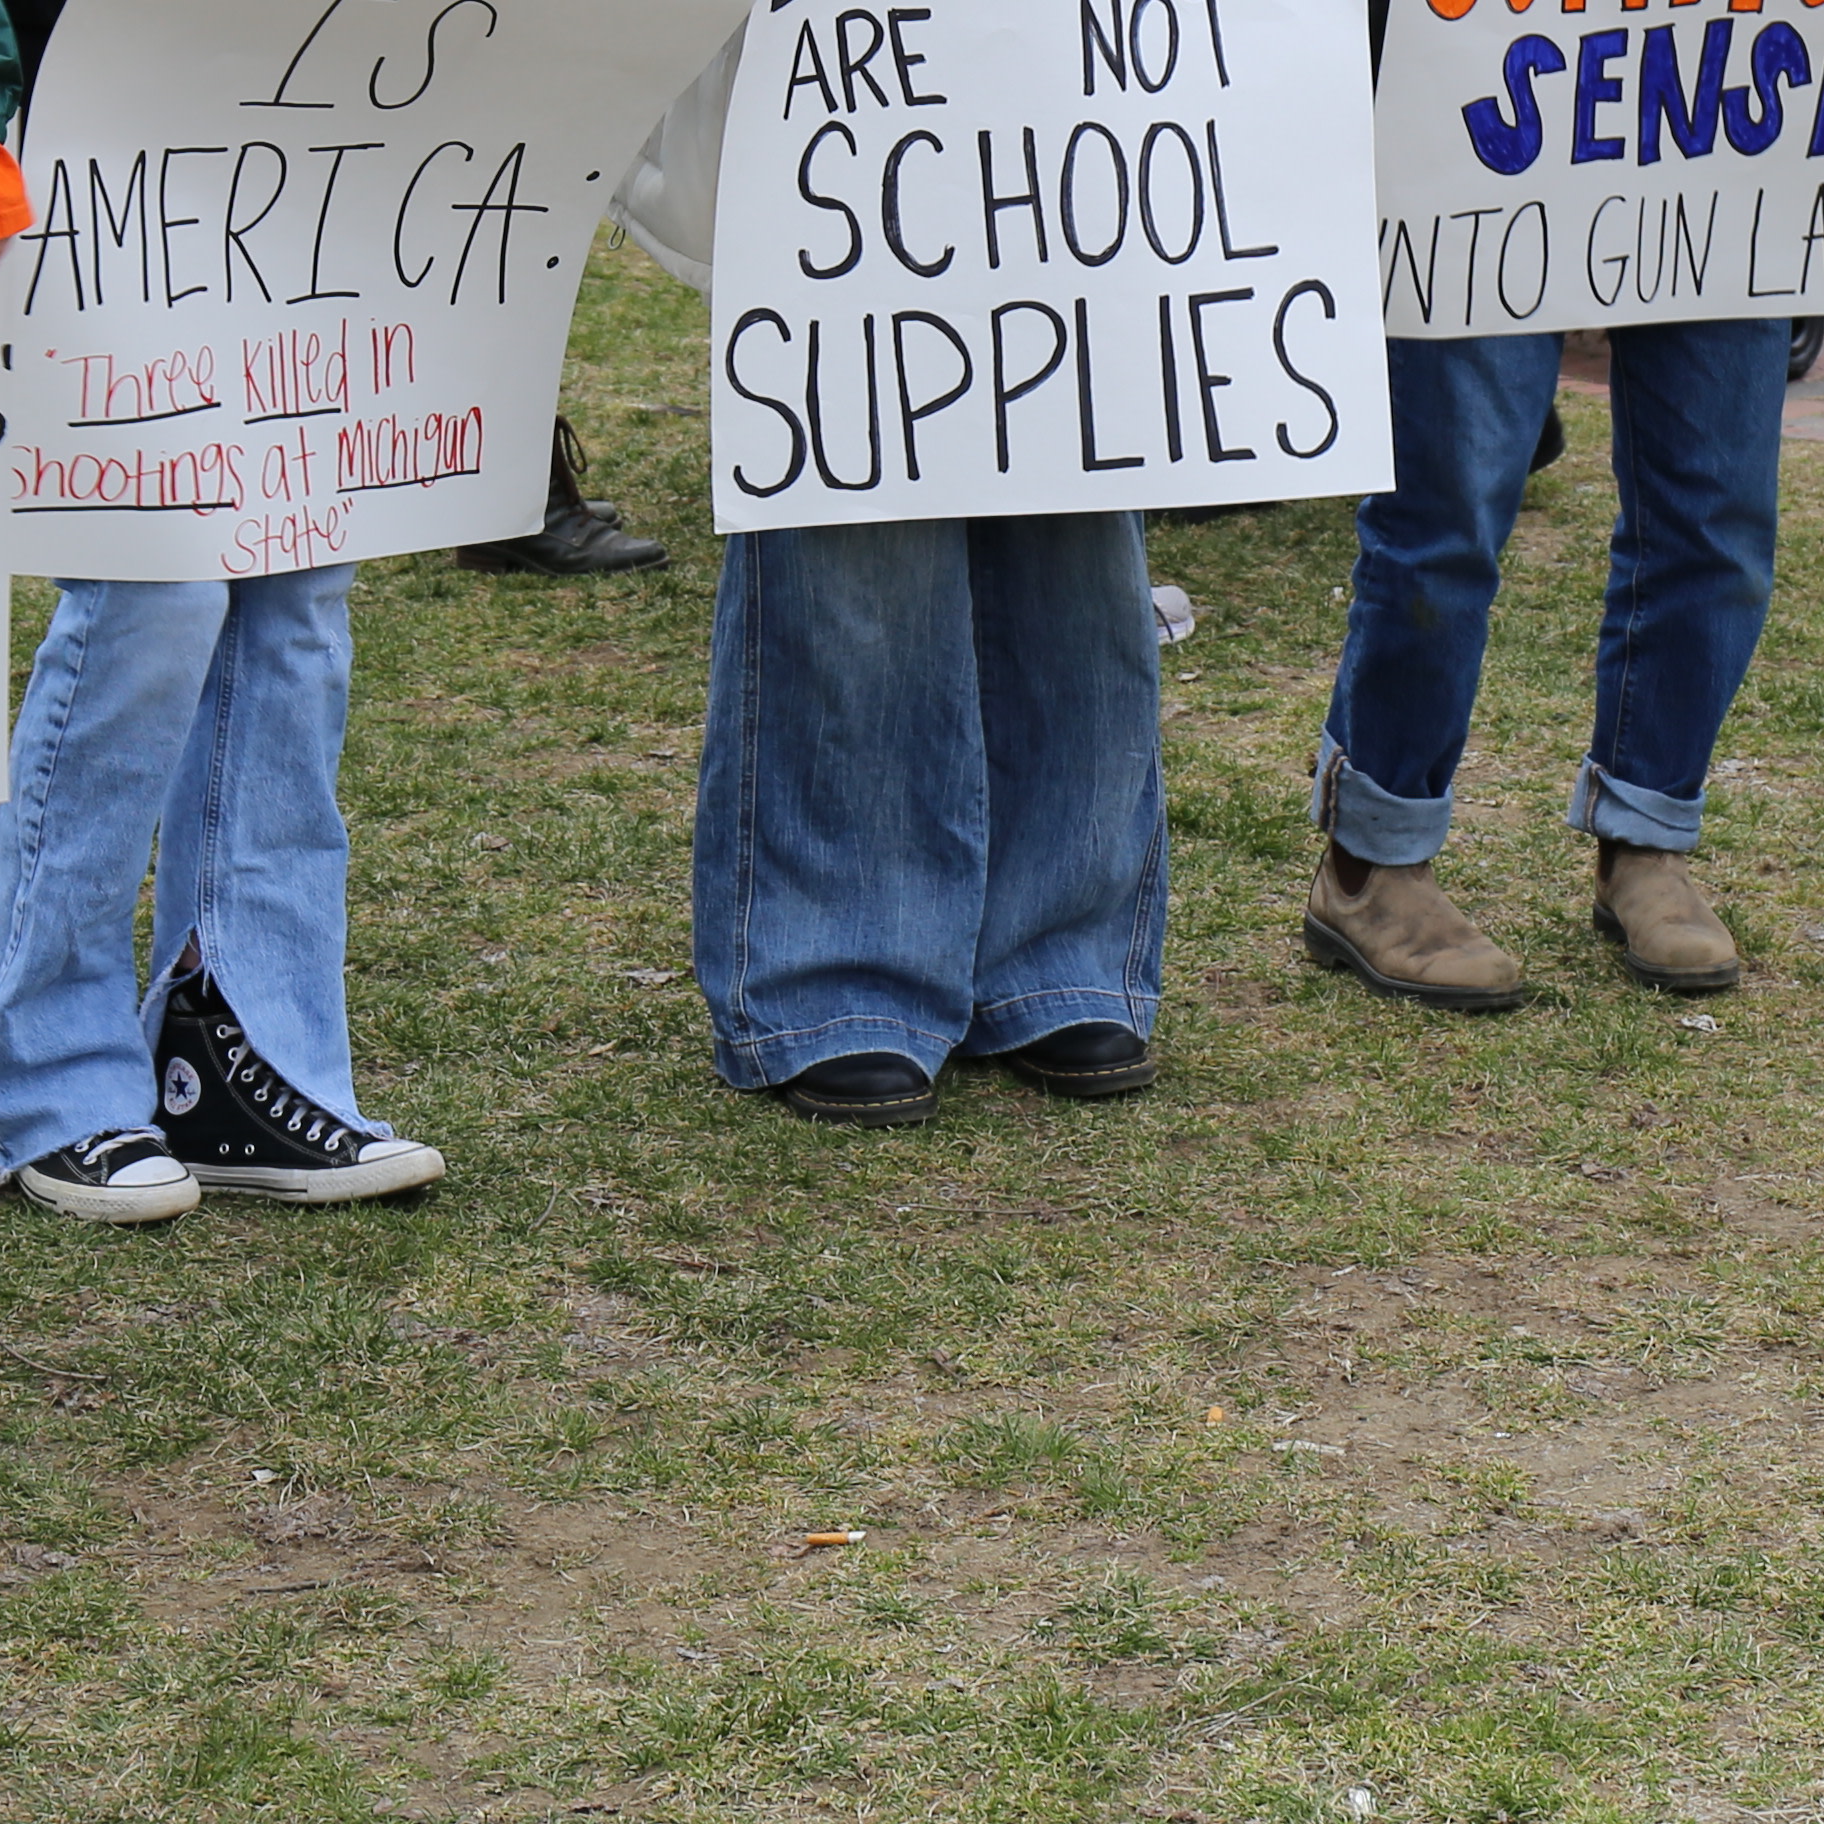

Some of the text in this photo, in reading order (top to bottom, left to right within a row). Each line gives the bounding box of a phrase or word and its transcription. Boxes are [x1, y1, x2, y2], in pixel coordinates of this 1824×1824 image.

[783, 6, 947, 121] ARE
[20, 140, 601, 316] AMERICA:
[797, 119, 1280, 279] SCHOOL
[1587, 191, 1718, 307] GUN
[371, 317, 415, 395] in
[724, 278, 1340, 498] SUPPLIES
[261, 425, 317, 502] at
